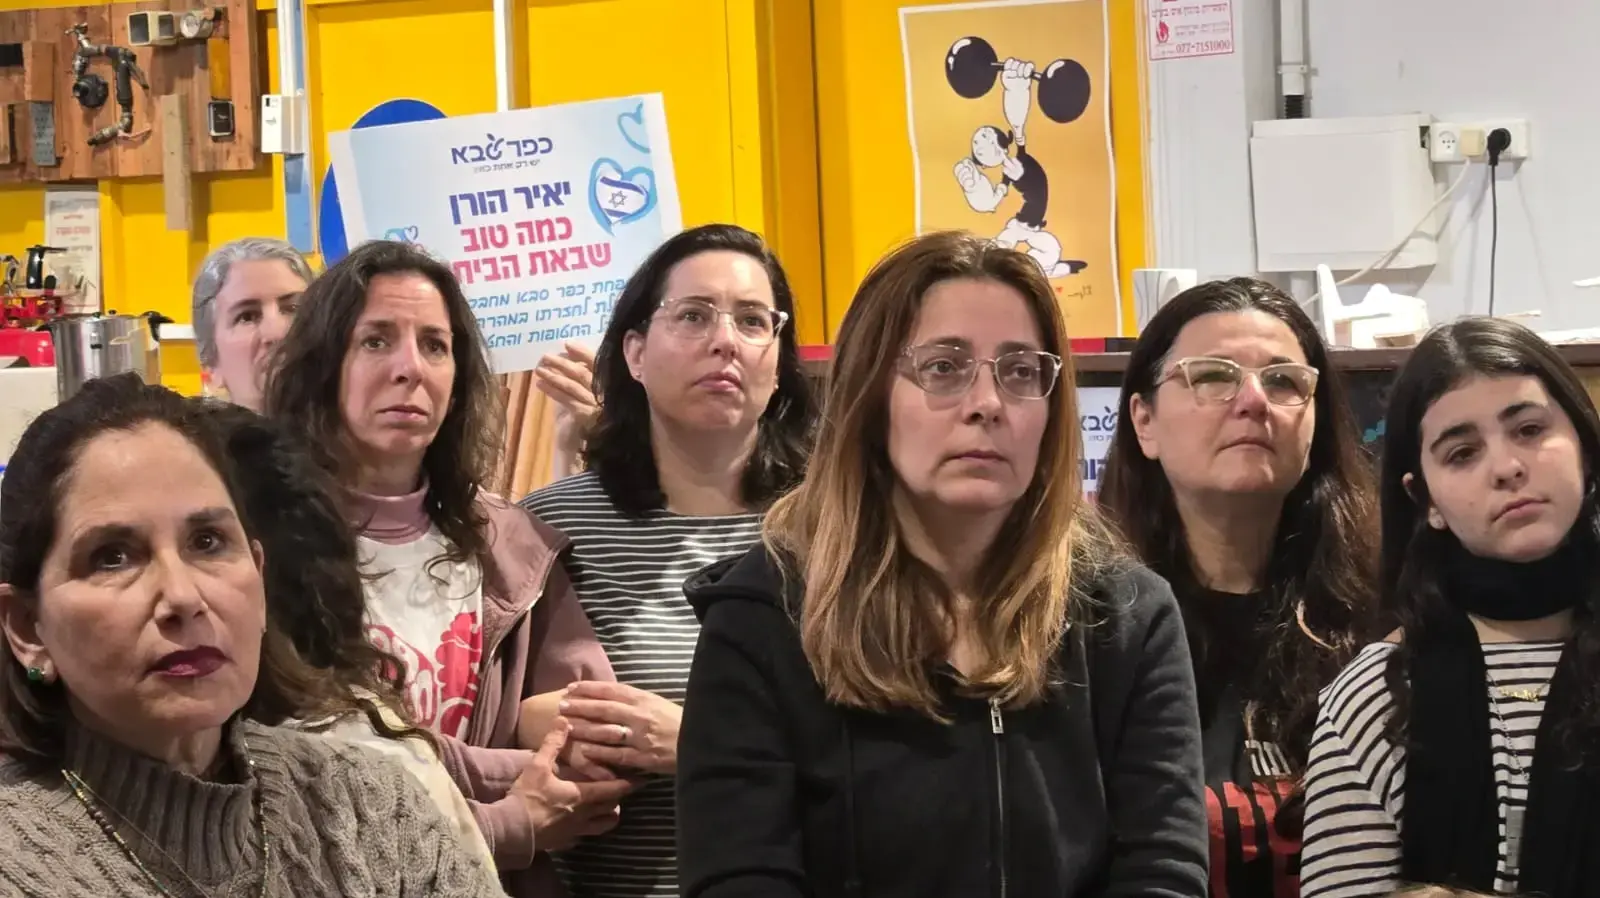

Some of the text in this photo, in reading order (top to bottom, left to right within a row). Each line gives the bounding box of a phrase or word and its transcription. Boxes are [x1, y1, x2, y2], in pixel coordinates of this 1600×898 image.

[1176, 40, 1230, 53] 077-7151000
[451, 133, 554, 165] כפר סבא
[449, 181, 572, 225] יאיר הורן
[460, 216, 573, 253] כמה טוב
[528, 242, 612, 276] שבאת
[556, 284, 586, 298] כפר
[592, 279, 626, 294] פחת
[516, 288, 550, 305] סבא
[487, 332, 522, 349] והחט
[528, 323, 592, 343] החטופות
